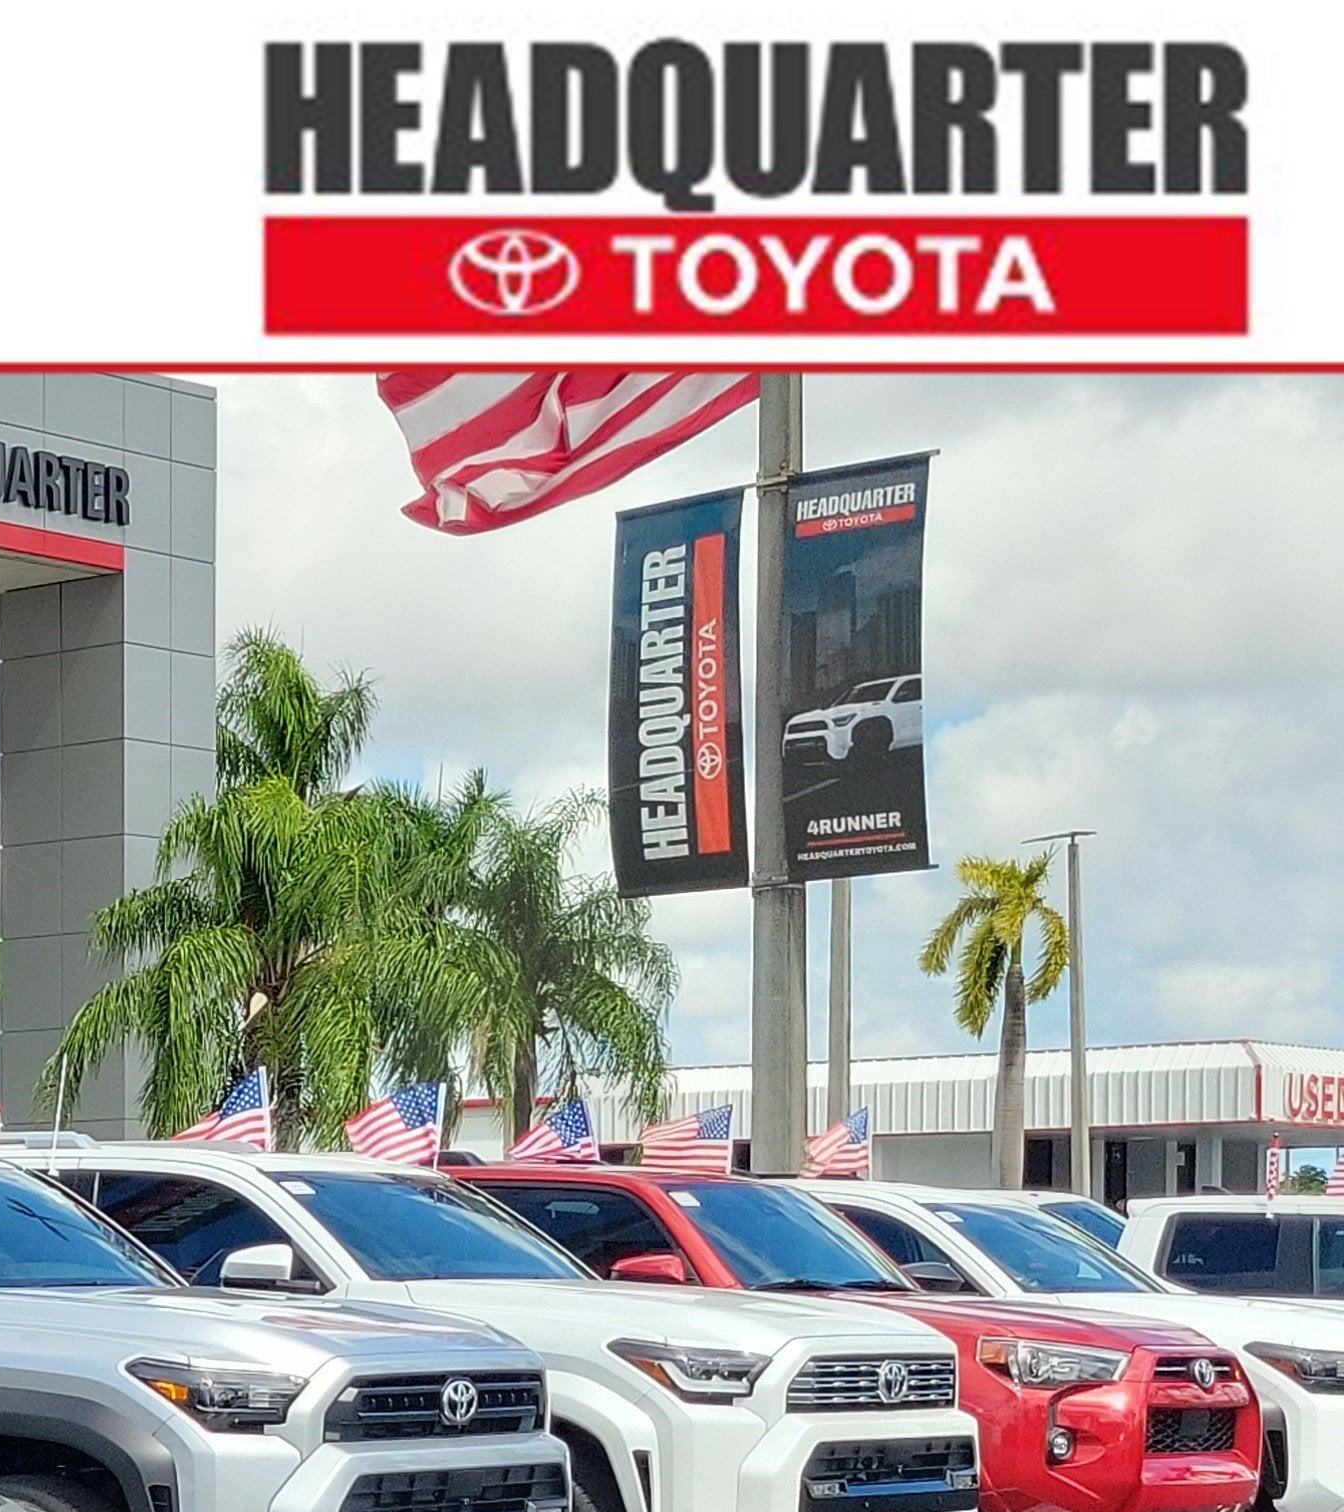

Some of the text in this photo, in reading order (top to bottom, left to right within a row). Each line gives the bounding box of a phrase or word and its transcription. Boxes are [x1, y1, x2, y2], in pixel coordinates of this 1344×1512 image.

[796, 483, 916, 522] HEADQUARTER
[838, 511, 883, 528] TOYOTA
[698, 618, 718, 740] TOYOTA
[638, 543, 690, 861] HEADQUARTER
[806, 811, 902, 836] 4RUNNER
